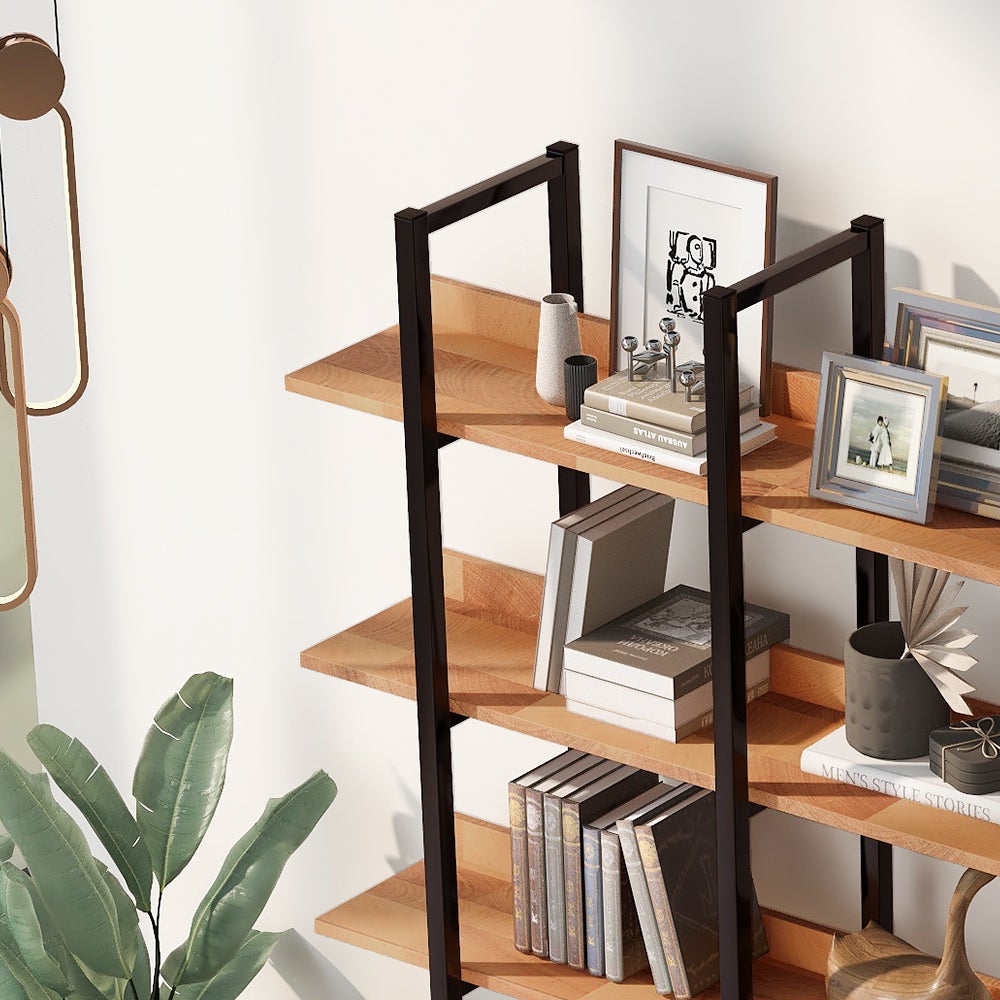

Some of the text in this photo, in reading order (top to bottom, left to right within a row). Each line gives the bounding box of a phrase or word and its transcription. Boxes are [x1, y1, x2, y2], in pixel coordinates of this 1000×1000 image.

[633, 427, 688, 449] AUSBAU ATLAS
[821, 763, 991, 823] MEN'S STYLE STORIES
